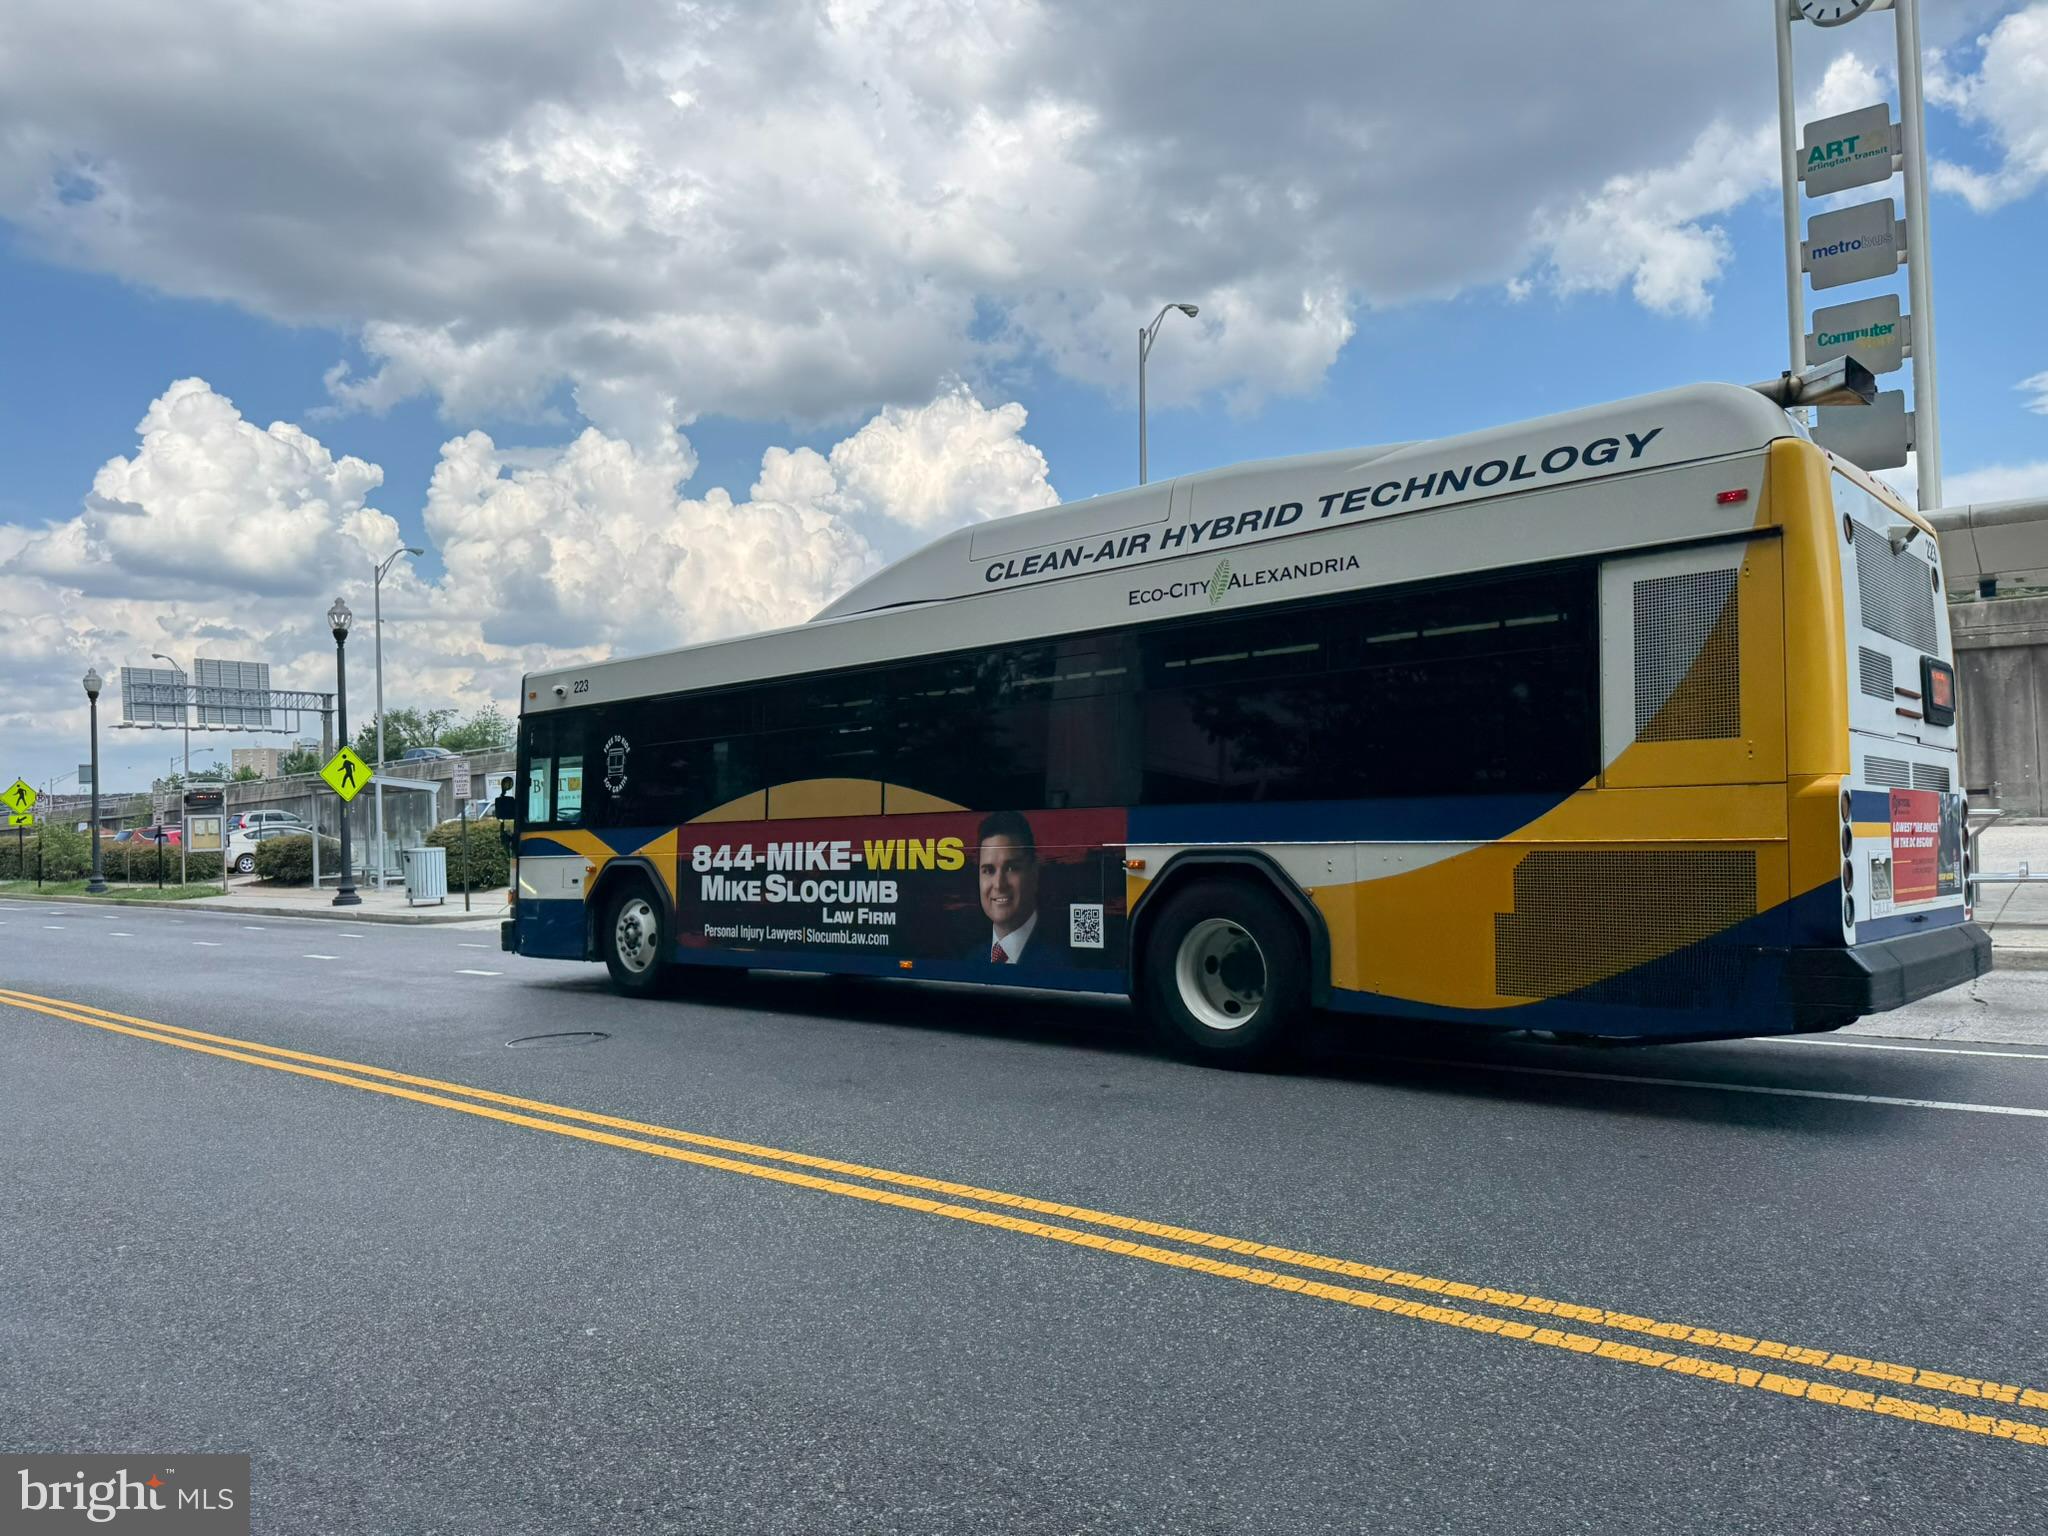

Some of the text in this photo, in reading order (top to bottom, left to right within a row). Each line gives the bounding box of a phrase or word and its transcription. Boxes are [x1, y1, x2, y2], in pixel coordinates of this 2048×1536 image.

[1807, 134, 1860, 165] ART
[1807, 146, 1889, 173] arlington transit
[1812, 232, 1894, 260] metrobus
[1817, 323, 1895, 347] Commuter
[985, 427, 1664, 583] CLEAN-AIR HYBRID TECHNOLOGY
[574, 679, 589, 694] 223
[691, 837, 965, 872] 844-MIKE-WINS
[704, 924, 889, 946] Personal Injury Lawyers SlocumbLaw.com
